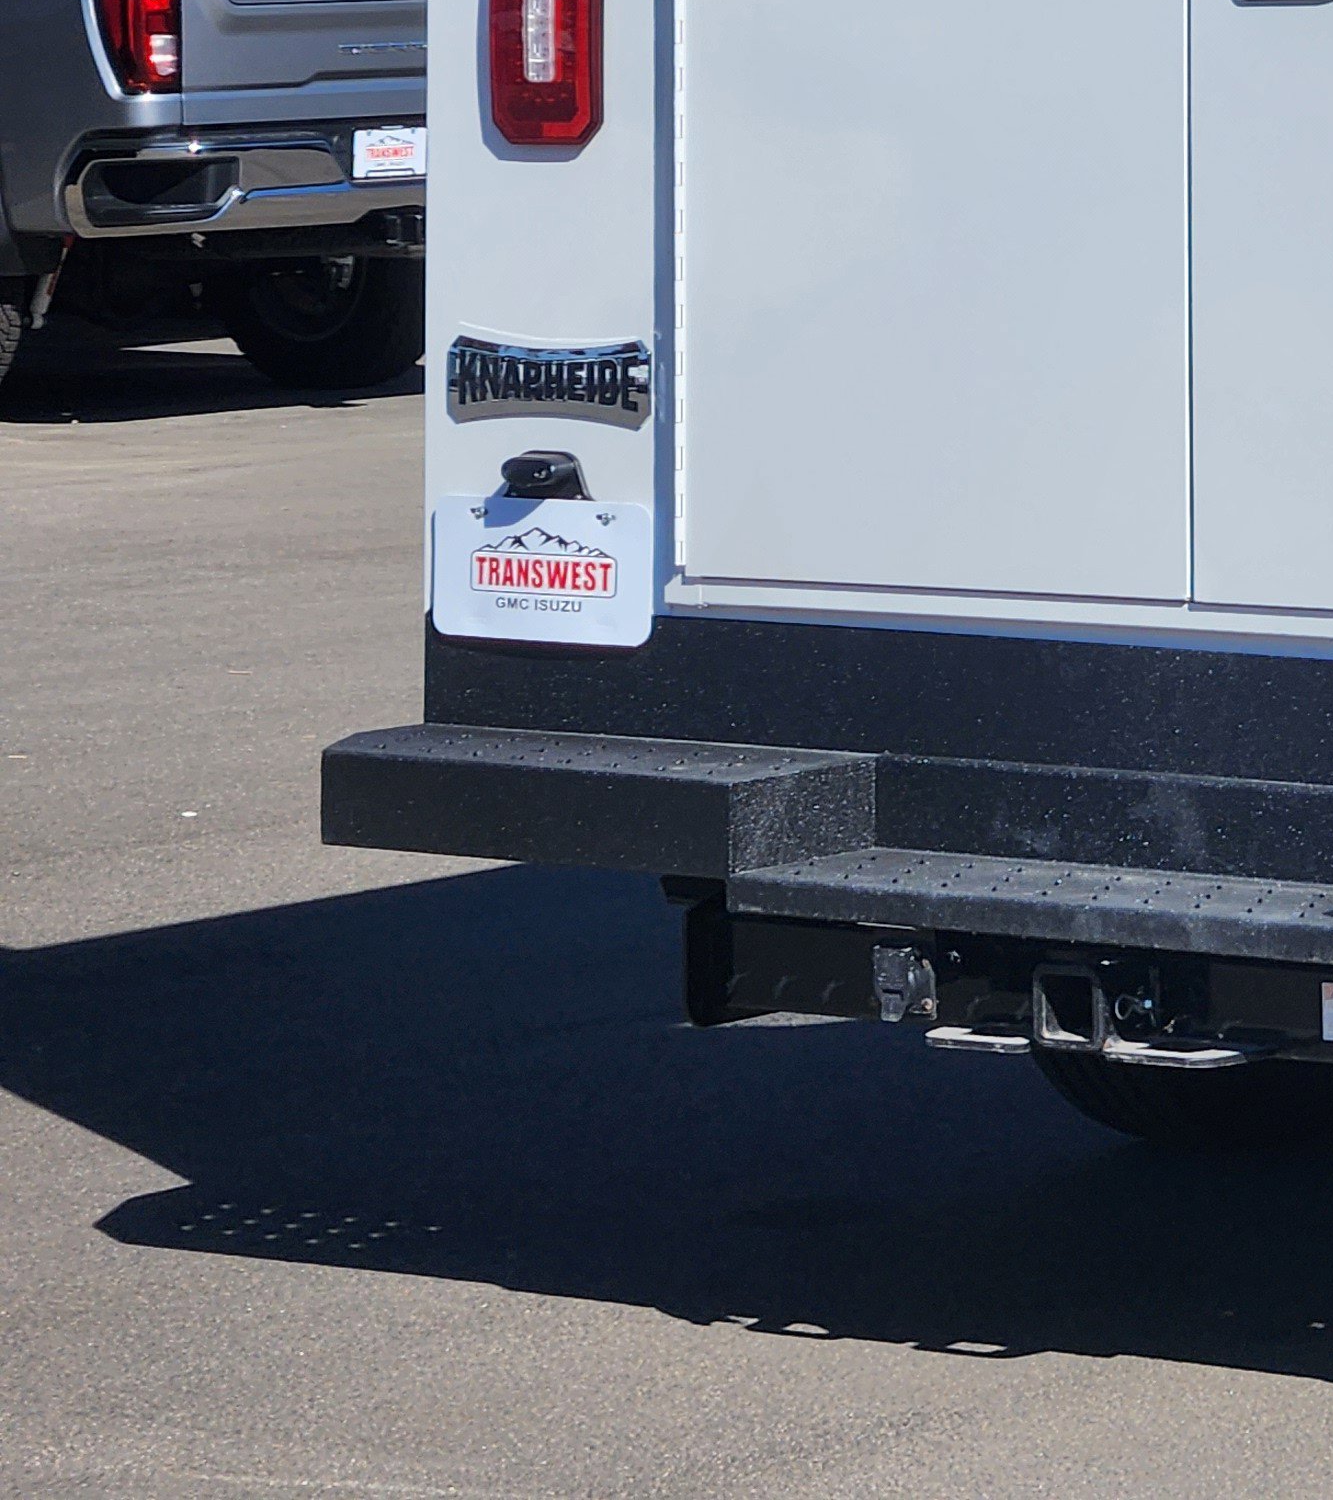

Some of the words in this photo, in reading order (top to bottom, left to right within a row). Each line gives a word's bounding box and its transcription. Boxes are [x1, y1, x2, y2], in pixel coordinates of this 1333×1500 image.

[458, 349, 639, 413] KNAPHEIDE
[476, 556, 612, 592] TRANSWEST
[496, 597, 529, 609] GMC
[535, 599, 582, 612] ISUZU
